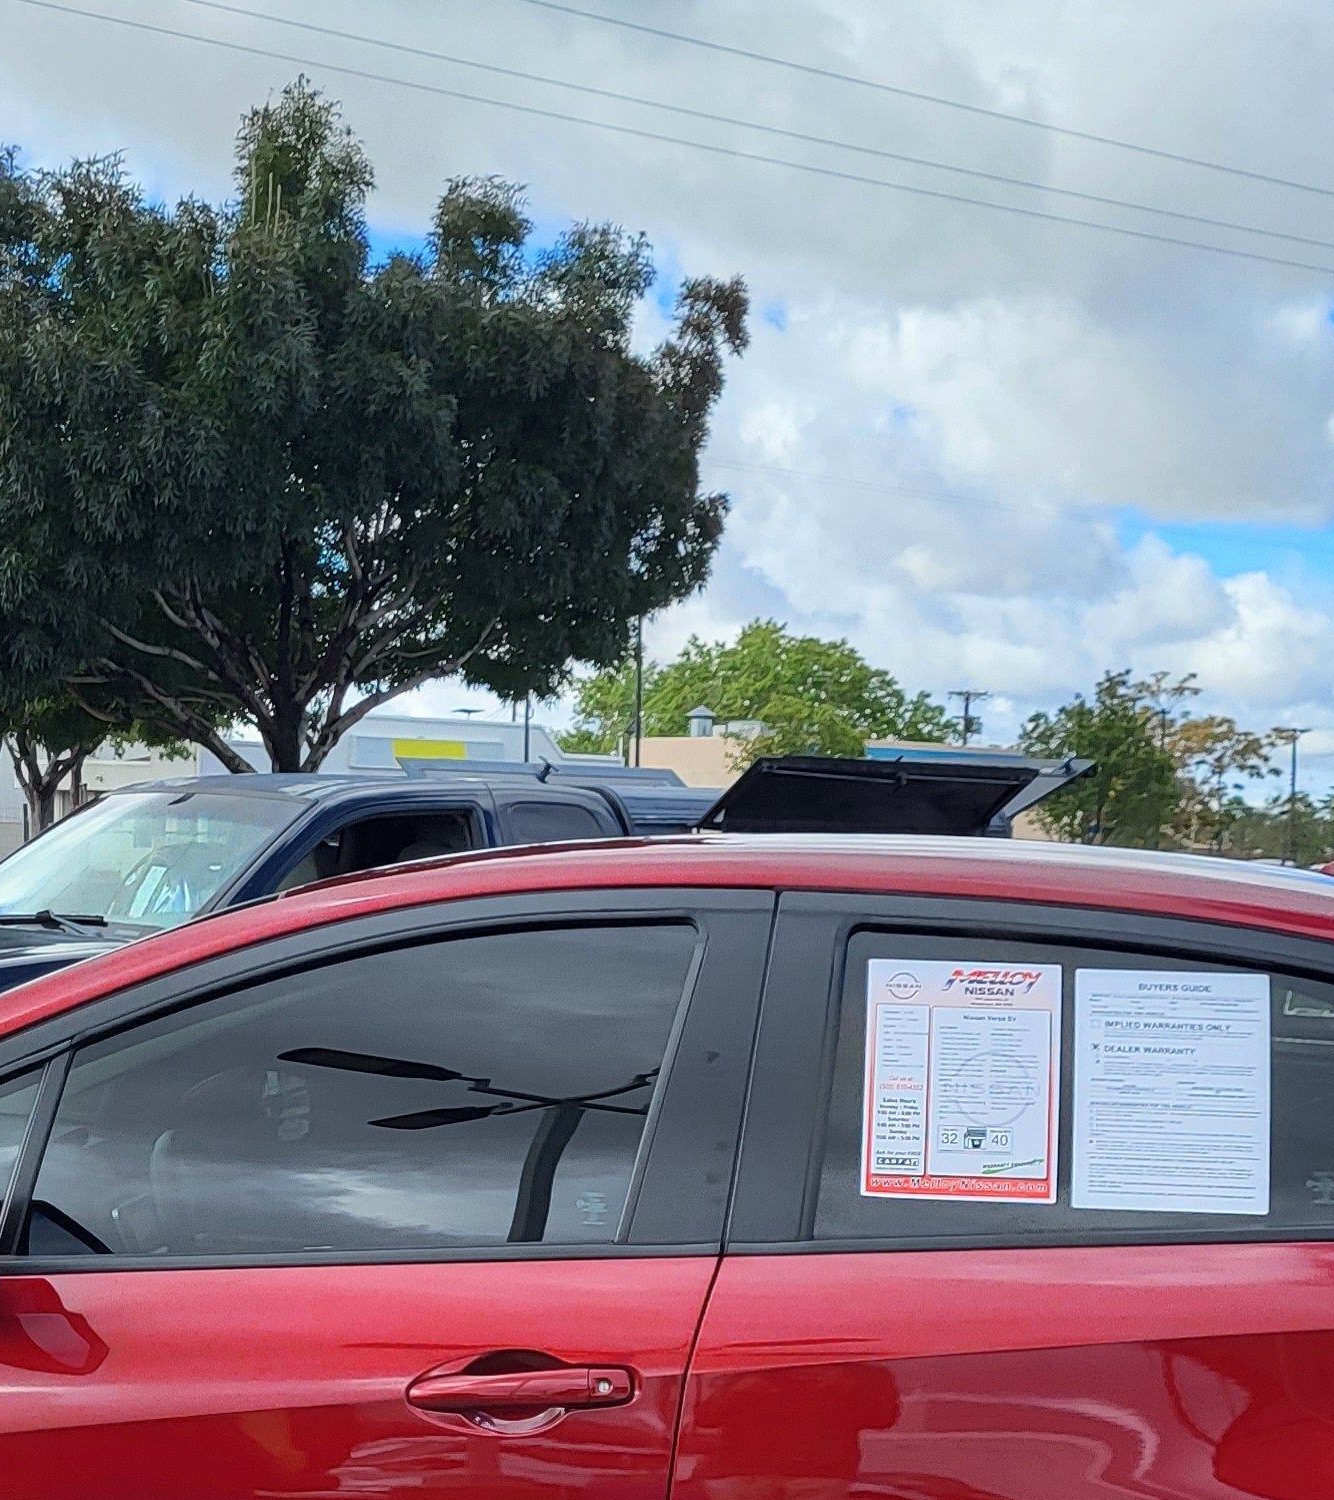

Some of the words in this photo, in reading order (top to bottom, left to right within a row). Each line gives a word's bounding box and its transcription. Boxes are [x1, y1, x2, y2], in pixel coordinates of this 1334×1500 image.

[963, 986, 1015, 997] NISSAN
[1138, 982, 1178, 992] BUYERS
[1181, 984, 1213, 993] GUIDE
[1104, 1045, 1141, 1054] DEALER
[1143, 1046, 1197, 1055] WARRANTY
[941, 1132, 958, 1145] 32
[991, 1134, 1009, 1147] 40
